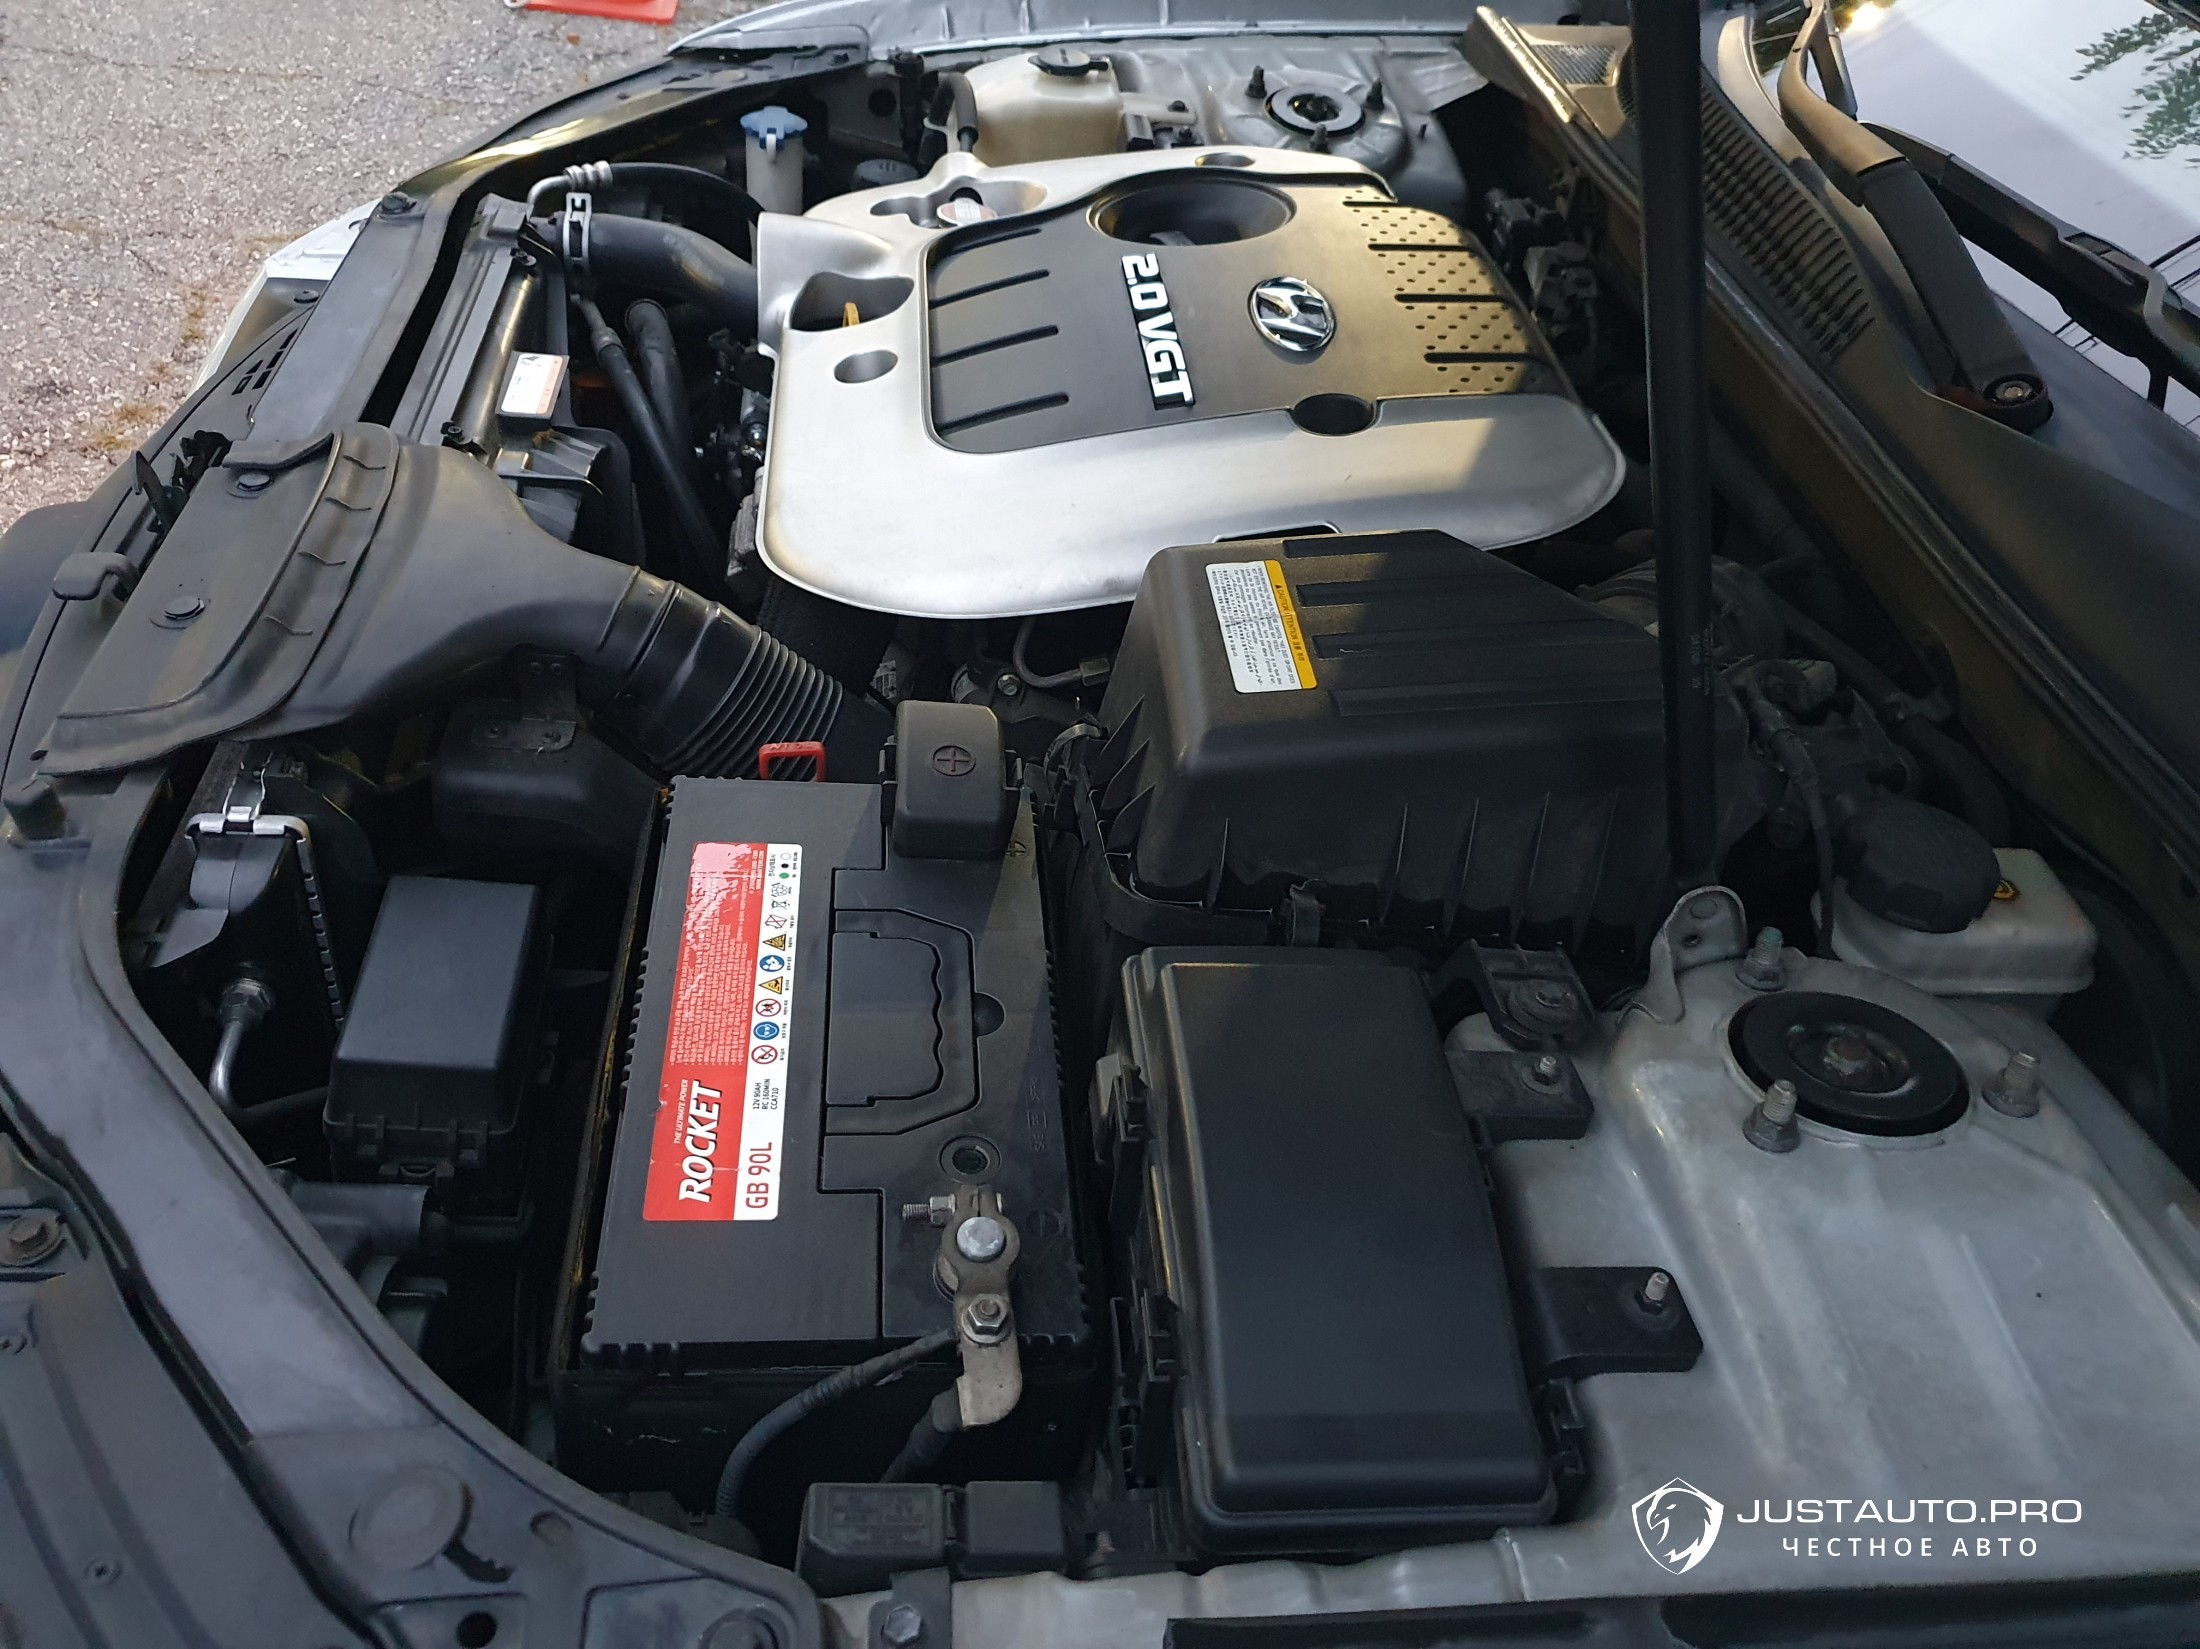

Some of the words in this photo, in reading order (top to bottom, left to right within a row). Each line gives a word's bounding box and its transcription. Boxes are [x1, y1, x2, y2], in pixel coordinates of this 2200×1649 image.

[1121, 252, 1168, 310] 2.0
[1138, 311, 1194, 405] VGT
[680, 1079, 688, 1102] POWER
[754, 1082, 762, 1098] 90AH
[762, 1078, 770, 1101] 160MIN
[770, 1087, 779, 1110] CCA710
[753, 1099, 761, 1110] 12V
[762, 1102, 769, 1110] RC
[676, 1103, 686, 1132] ULTIMATE
[674, 1132, 684, 1144] THE
[679, 1079, 722, 1203] ROCKET
[748, 1142, 772, 1176] 90L
[745, 1182, 769, 1208] GB
